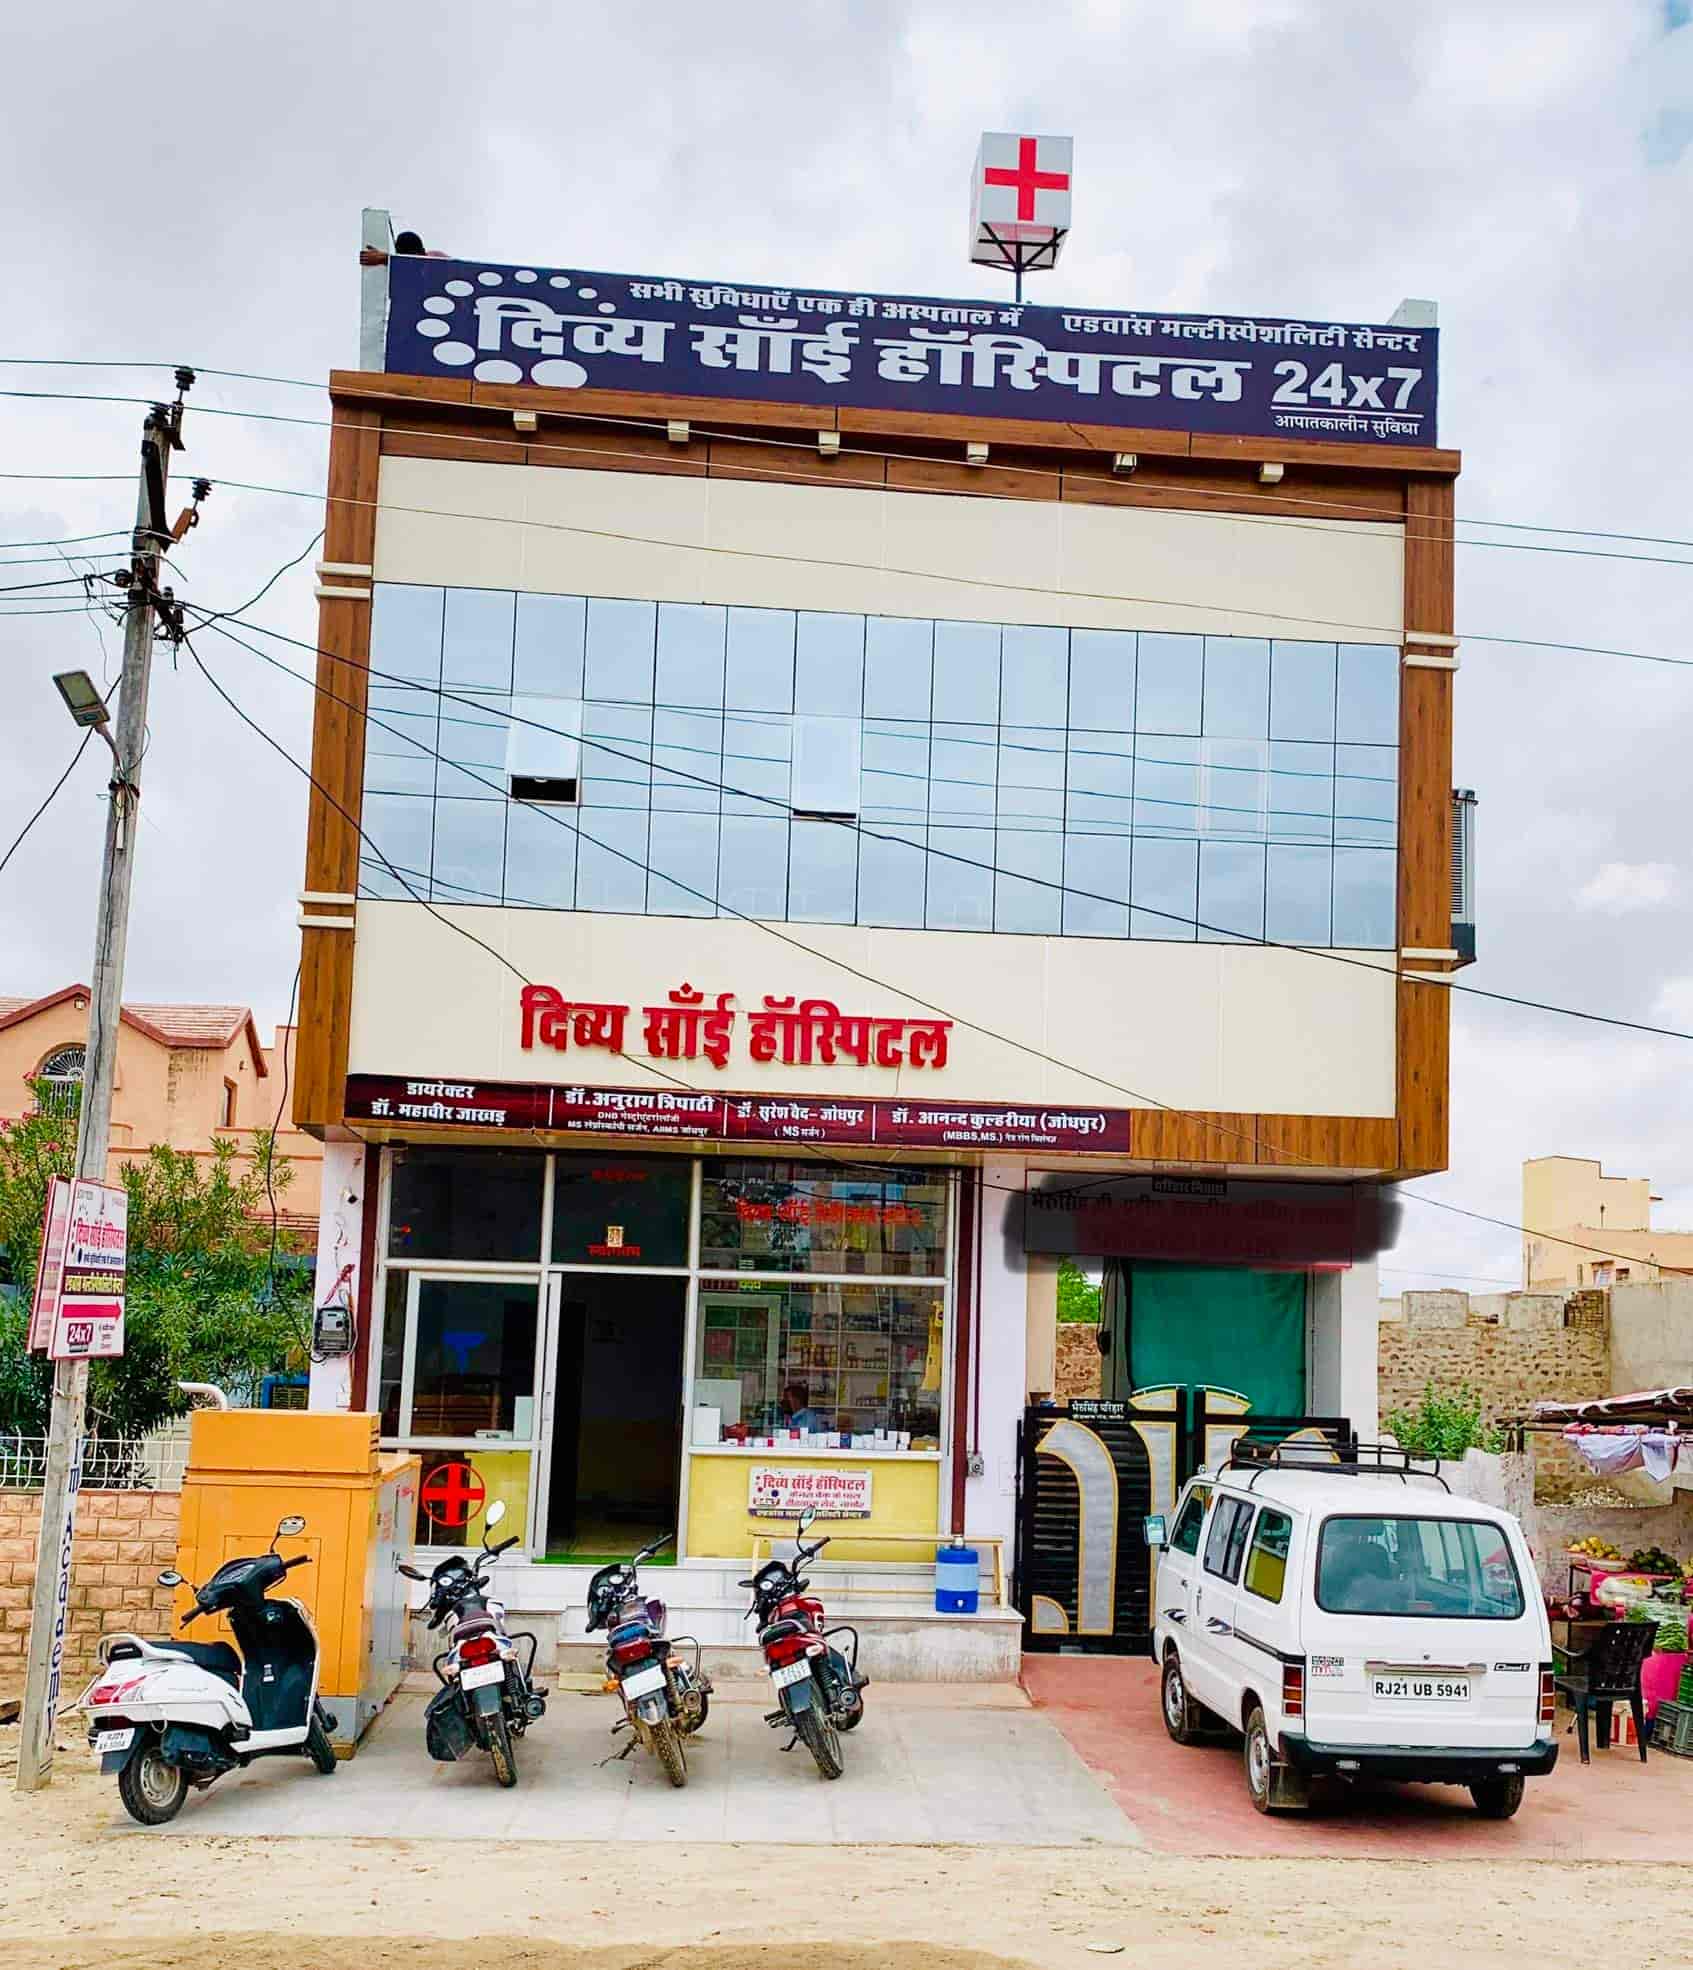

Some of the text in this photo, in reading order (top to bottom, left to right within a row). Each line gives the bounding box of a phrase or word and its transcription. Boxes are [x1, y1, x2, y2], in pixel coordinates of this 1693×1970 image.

[629, 281, 686, 303] सभी
[796, 294, 845, 315] एक
[848, 296, 878, 318] ही
[881, 300, 994, 327] अस्पताल
[999, 306, 1025, 328] में
[1062, 312, 1421, 354] एडवांस मल्टीस्पेशलिटी सेन्टर
[474, 295, 675, 363] दिव्य
[873, 326, 1253, 402] हॉस्पिटल
[1272, 359, 1423, 410] 24x7
[1274, 413, 1420, 437] आपातकालीन सुविधा
[519, 982, 953, 1069] दिव्य साँई हॉस्पिटल
[406, 1081, 475, 1100] डायरेक्टर
[657, 1093, 714, 1112] त्रिपाठी
[371, 1098, 506, 1124] डॉ. महावीर जाखड़
[820, 1105, 864, 1126] जोधपुर
[891, 1107, 915, 1126] डॉ.
[917, 1110, 968, 1128] आनन्द
[68, 1323, 92, 1345] 24x7
[1375, 1681, 1469, 1697] RJ21 UB 5941
